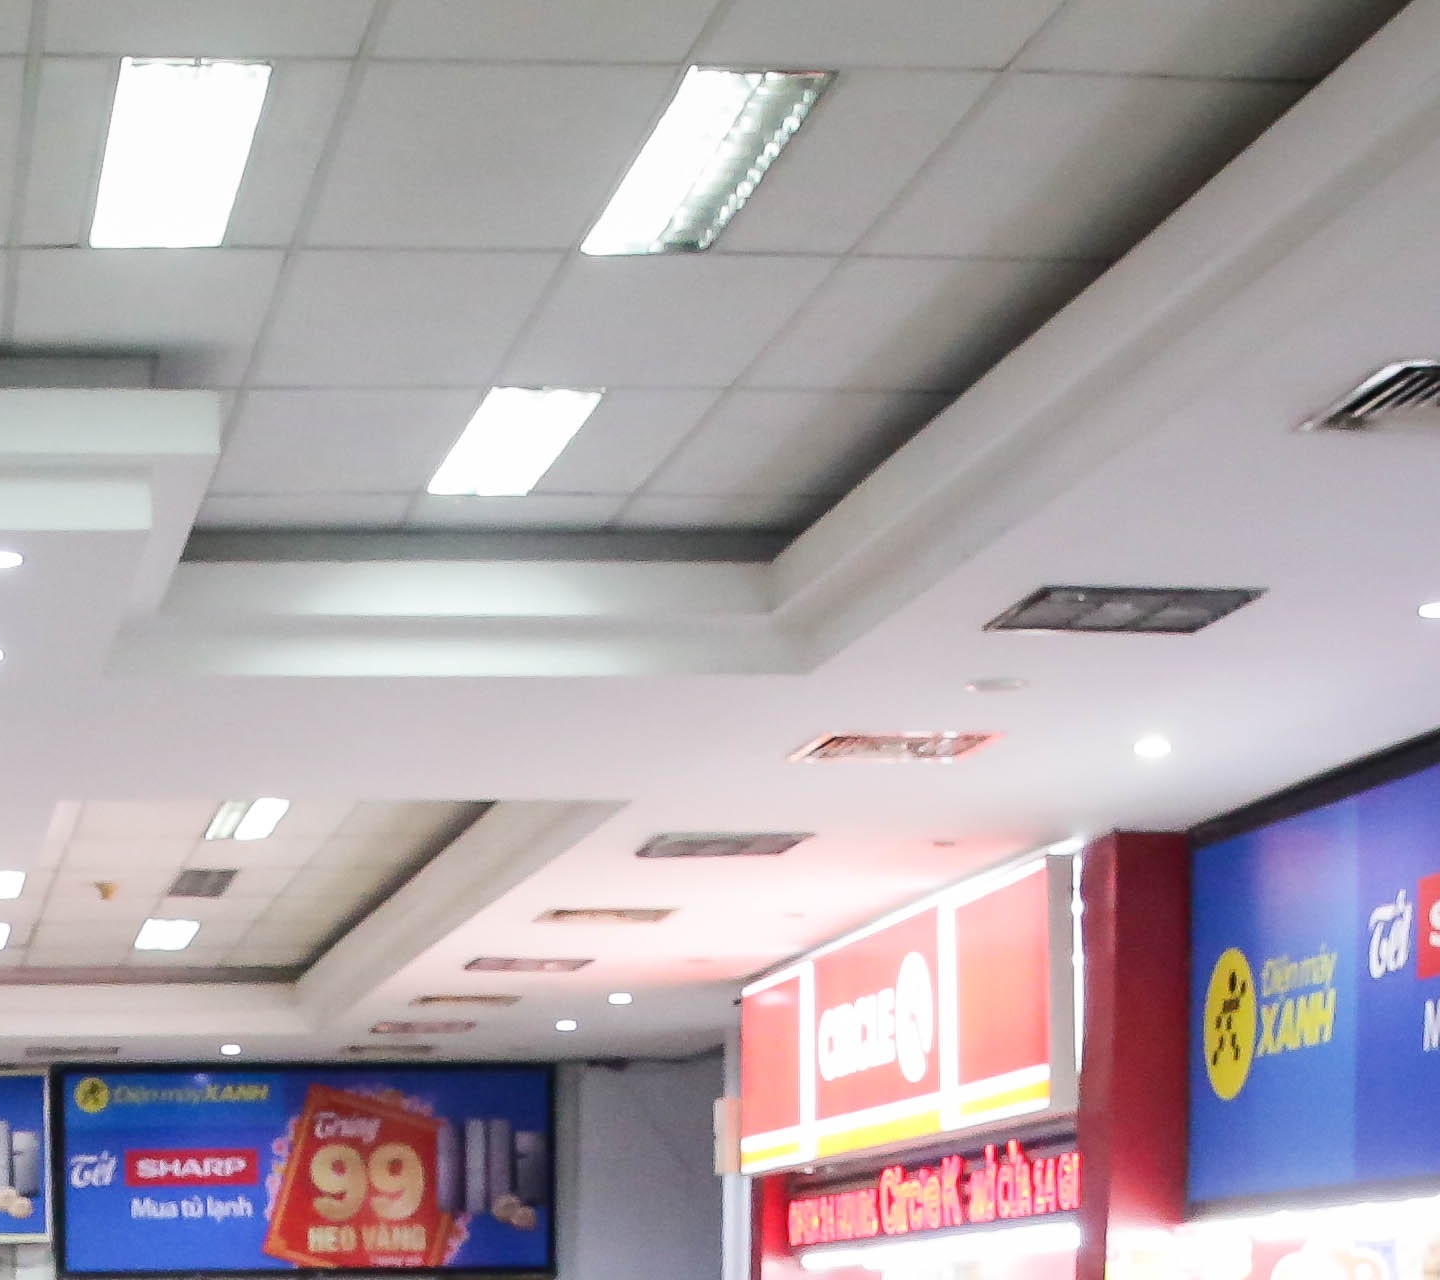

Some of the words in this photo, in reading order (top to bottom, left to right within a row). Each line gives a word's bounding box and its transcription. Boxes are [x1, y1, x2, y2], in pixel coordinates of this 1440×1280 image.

[1257, 987, 1337, 1056] XANH
[136, 1158, 248, 1179] SHARP
[309, 1143, 426, 1222] 99
[131, 1197, 178, 1219] Mua
[181, 1195, 205, 1217] tủ
[207, 1196, 254, 1221] lạnh
[307, 1225, 357, 1253] HEO
[361, 1222, 427, 1251] VÀNG
